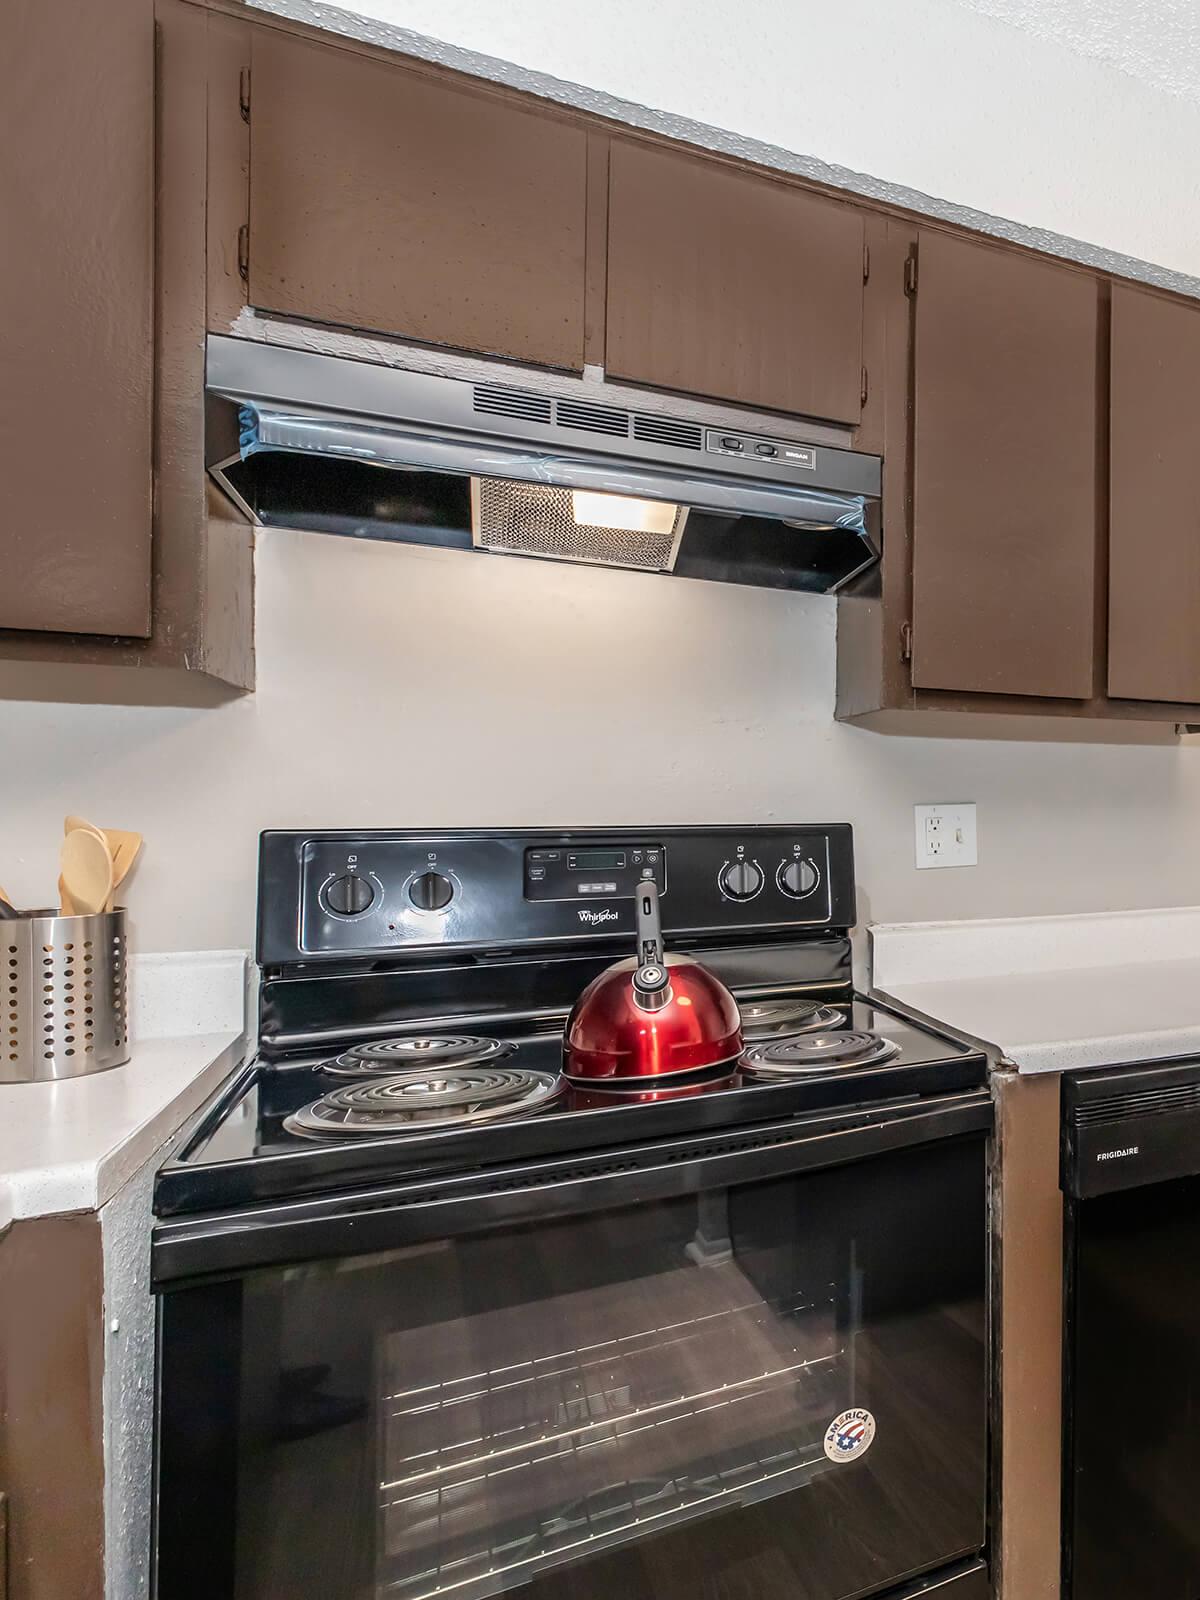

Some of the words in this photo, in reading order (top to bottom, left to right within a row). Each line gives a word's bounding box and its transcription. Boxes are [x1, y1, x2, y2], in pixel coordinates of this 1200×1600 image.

[577, 909, 619, 925] Whirlpool
[1096, 1146, 1139, 1161] FRIGIDAIRE
[827, 1411, 869, 1442] AMERICA
